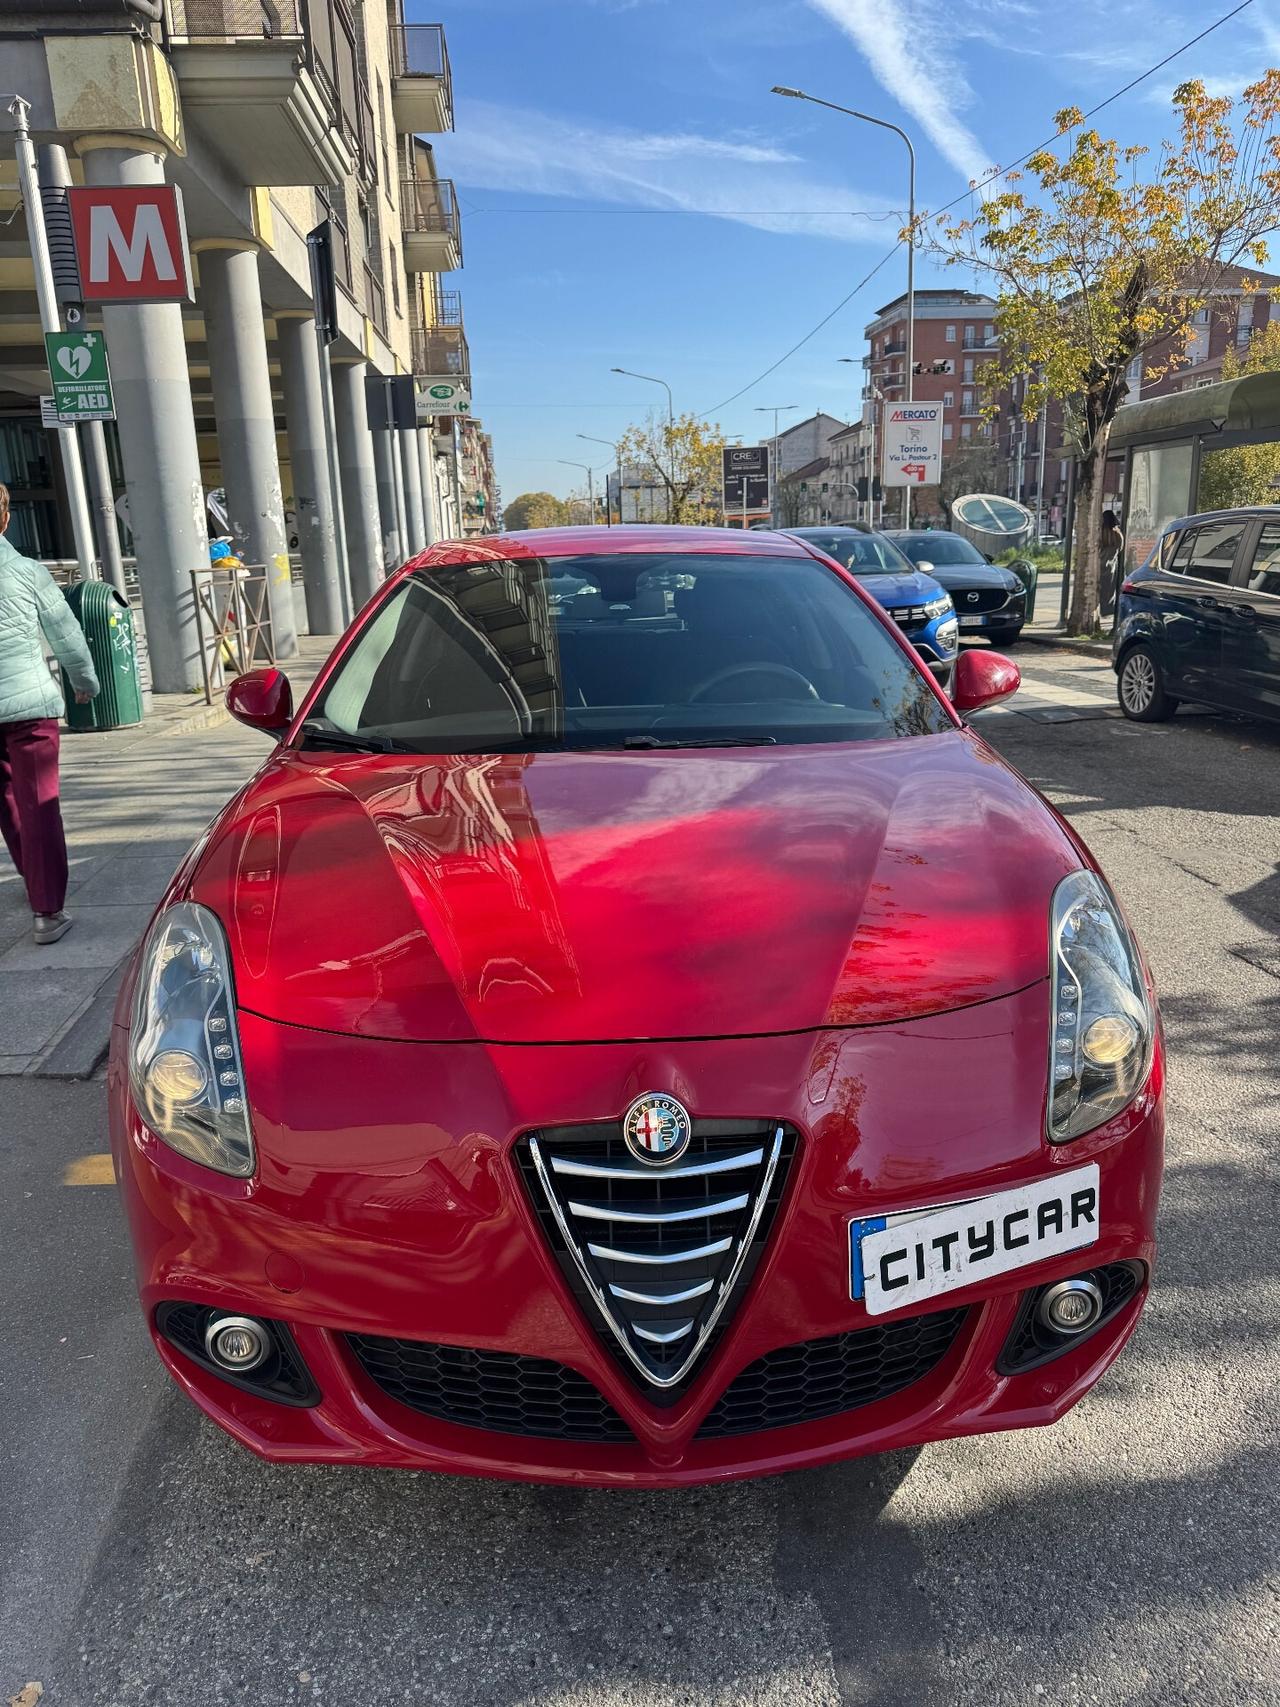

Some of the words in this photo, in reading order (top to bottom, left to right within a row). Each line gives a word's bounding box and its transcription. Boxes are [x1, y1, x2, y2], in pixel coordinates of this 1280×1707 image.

[89, 204, 178, 283] M
[57, 384, 107, 393] DEFIBRILLATORE
[78, 393, 109, 409] AED
[416, 400, 450, 409] Carrefour
[899, 444, 928, 453] Torino
[628, 1104, 648, 1133] ALFA
[654, 1100, 686, 1129] ROMEO
[879, 1187, 1096, 1292] CITYCAR
